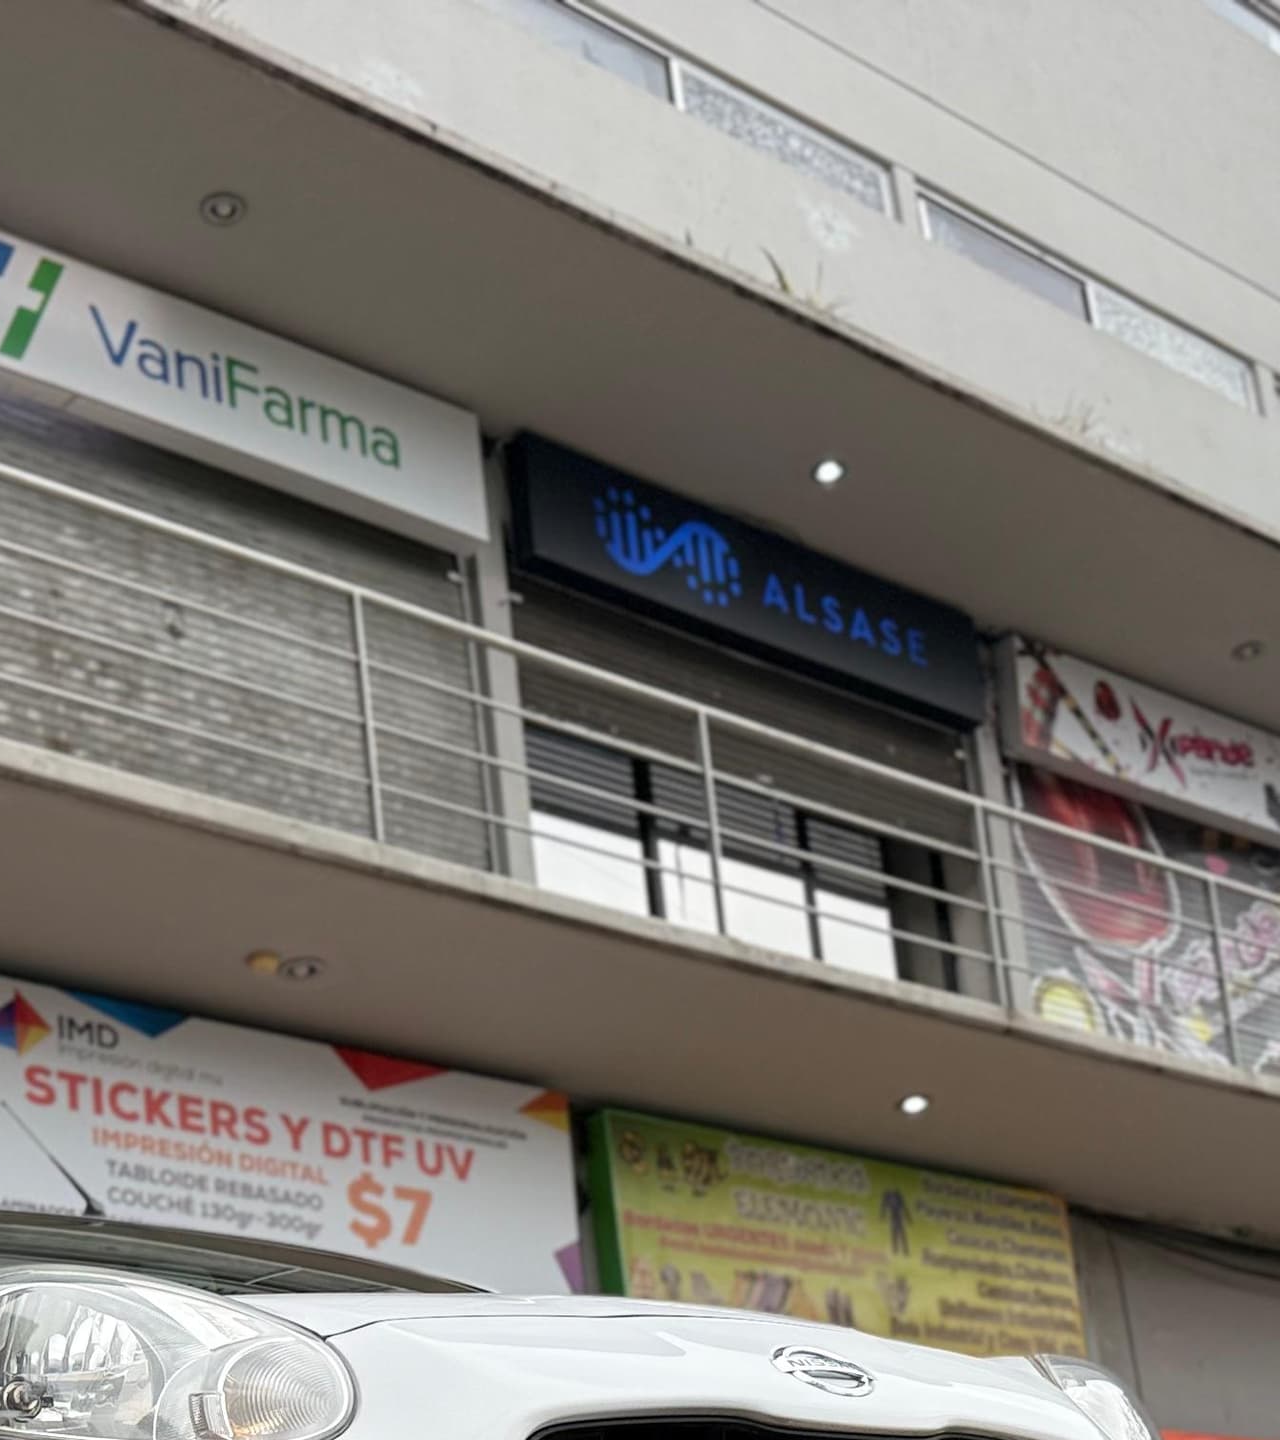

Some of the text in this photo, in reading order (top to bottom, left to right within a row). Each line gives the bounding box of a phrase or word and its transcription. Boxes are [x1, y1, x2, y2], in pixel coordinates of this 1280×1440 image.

[89, 303, 402, 469] VaniFarma
[762, 573, 928, 667] ALSASE
[58, 1014, 119, 1049] IMD
[24, 1064, 272, 1147] STICKERS
[280, 1112, 311, 1151] Y
[321, 1121, 406, 1168] DTF
[415, 1138, 475, 1181] UV
[91, 1127, 331, 1187] IMPRESIÓN DIGITAL
[107, 1159, 324, 1211] TABLOIDE REBASADO
[107, 1185, 195, 1217] COUCHÉ
[347, 1171, 434, 1249] $7
